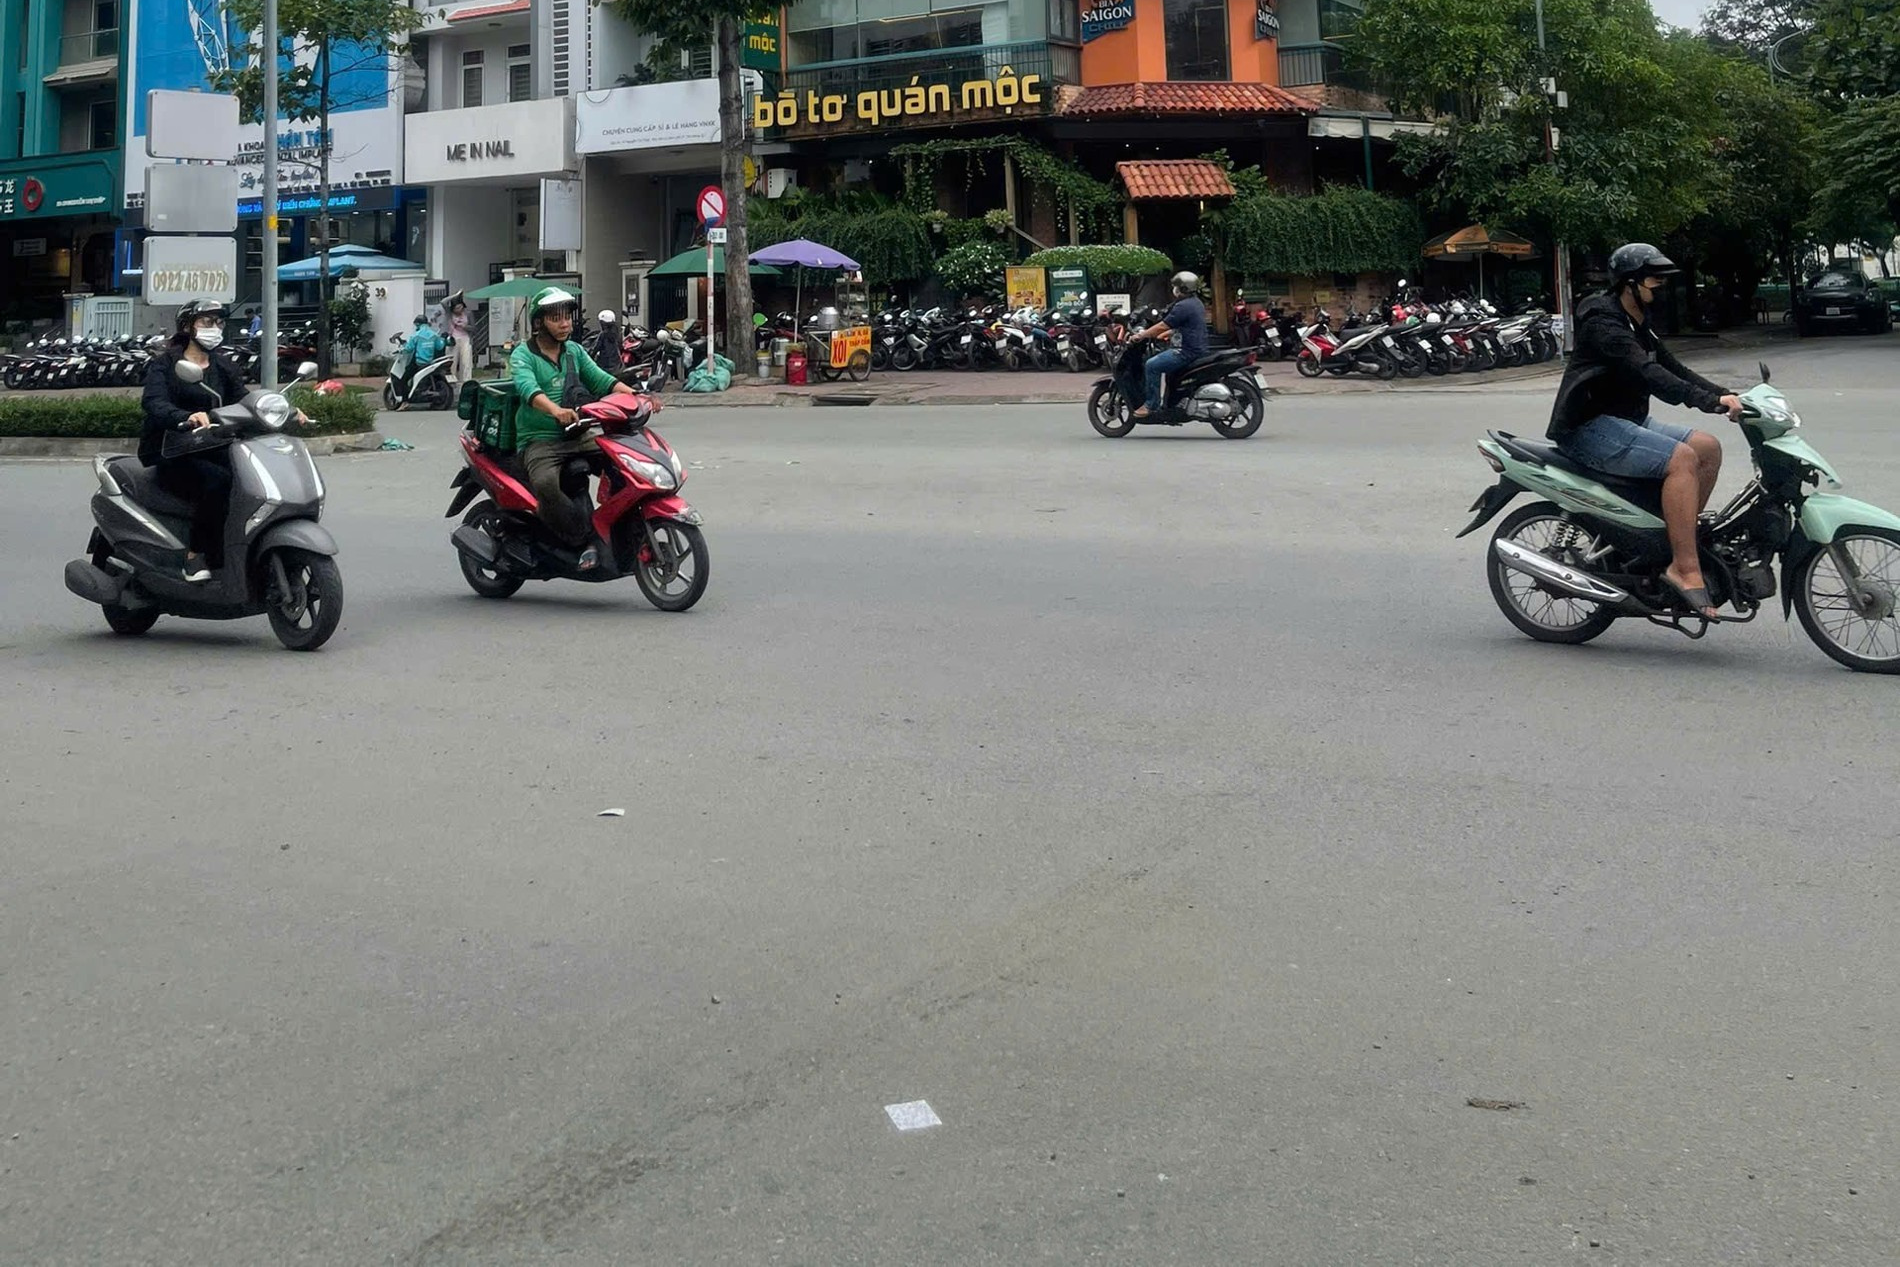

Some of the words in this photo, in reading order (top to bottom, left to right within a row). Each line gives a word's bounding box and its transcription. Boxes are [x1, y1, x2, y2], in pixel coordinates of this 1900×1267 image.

[1098, 0, 1114, 8] BIA
[1082, 6, 1132, 23] SAIGON
[1257, 9, 1280, 29] SAIGON
[749, 32, 776, 55] mộc
[807, 89, 848, 124] tơ
[857, 75, 950, 126] quán
[962, 65, 1041, 115] mộc
[446, 143, 466, 161] ME
[470, 142, 483, 159] IN
[486, 139, 515, 158] NAIL
[375, 287, 387, 298] 39
